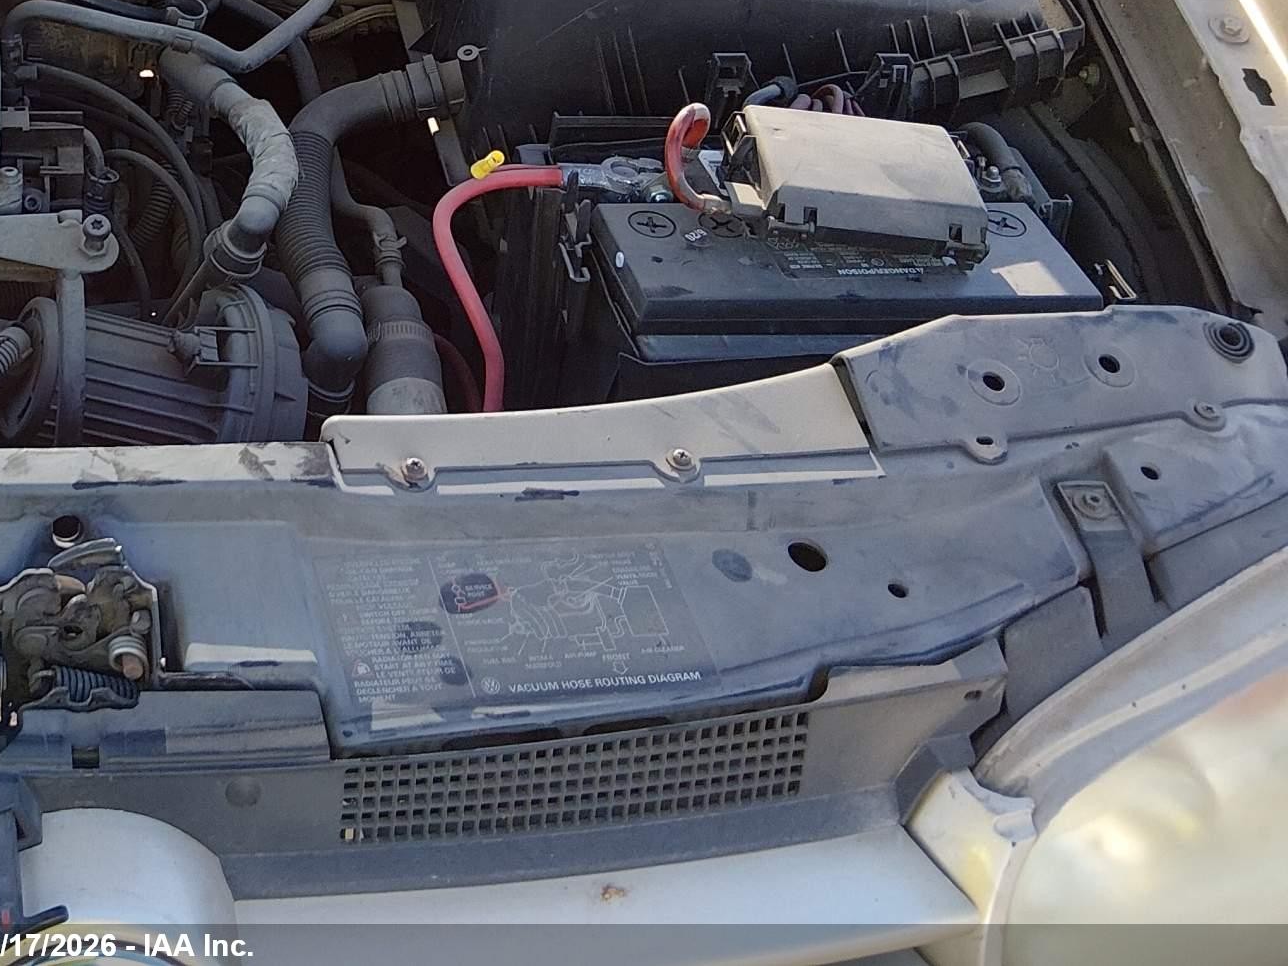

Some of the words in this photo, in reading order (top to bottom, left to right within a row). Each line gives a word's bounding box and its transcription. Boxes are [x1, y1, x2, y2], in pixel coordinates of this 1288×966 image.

[601, 653, 631, 661] FRONT
[508, 682, 560, 693] VACUUM
[561, 679, 594, 690] HOSE
[594, 675, 647, 687] ROUTING
[647, 671, 702, 684] DIAGRAM
